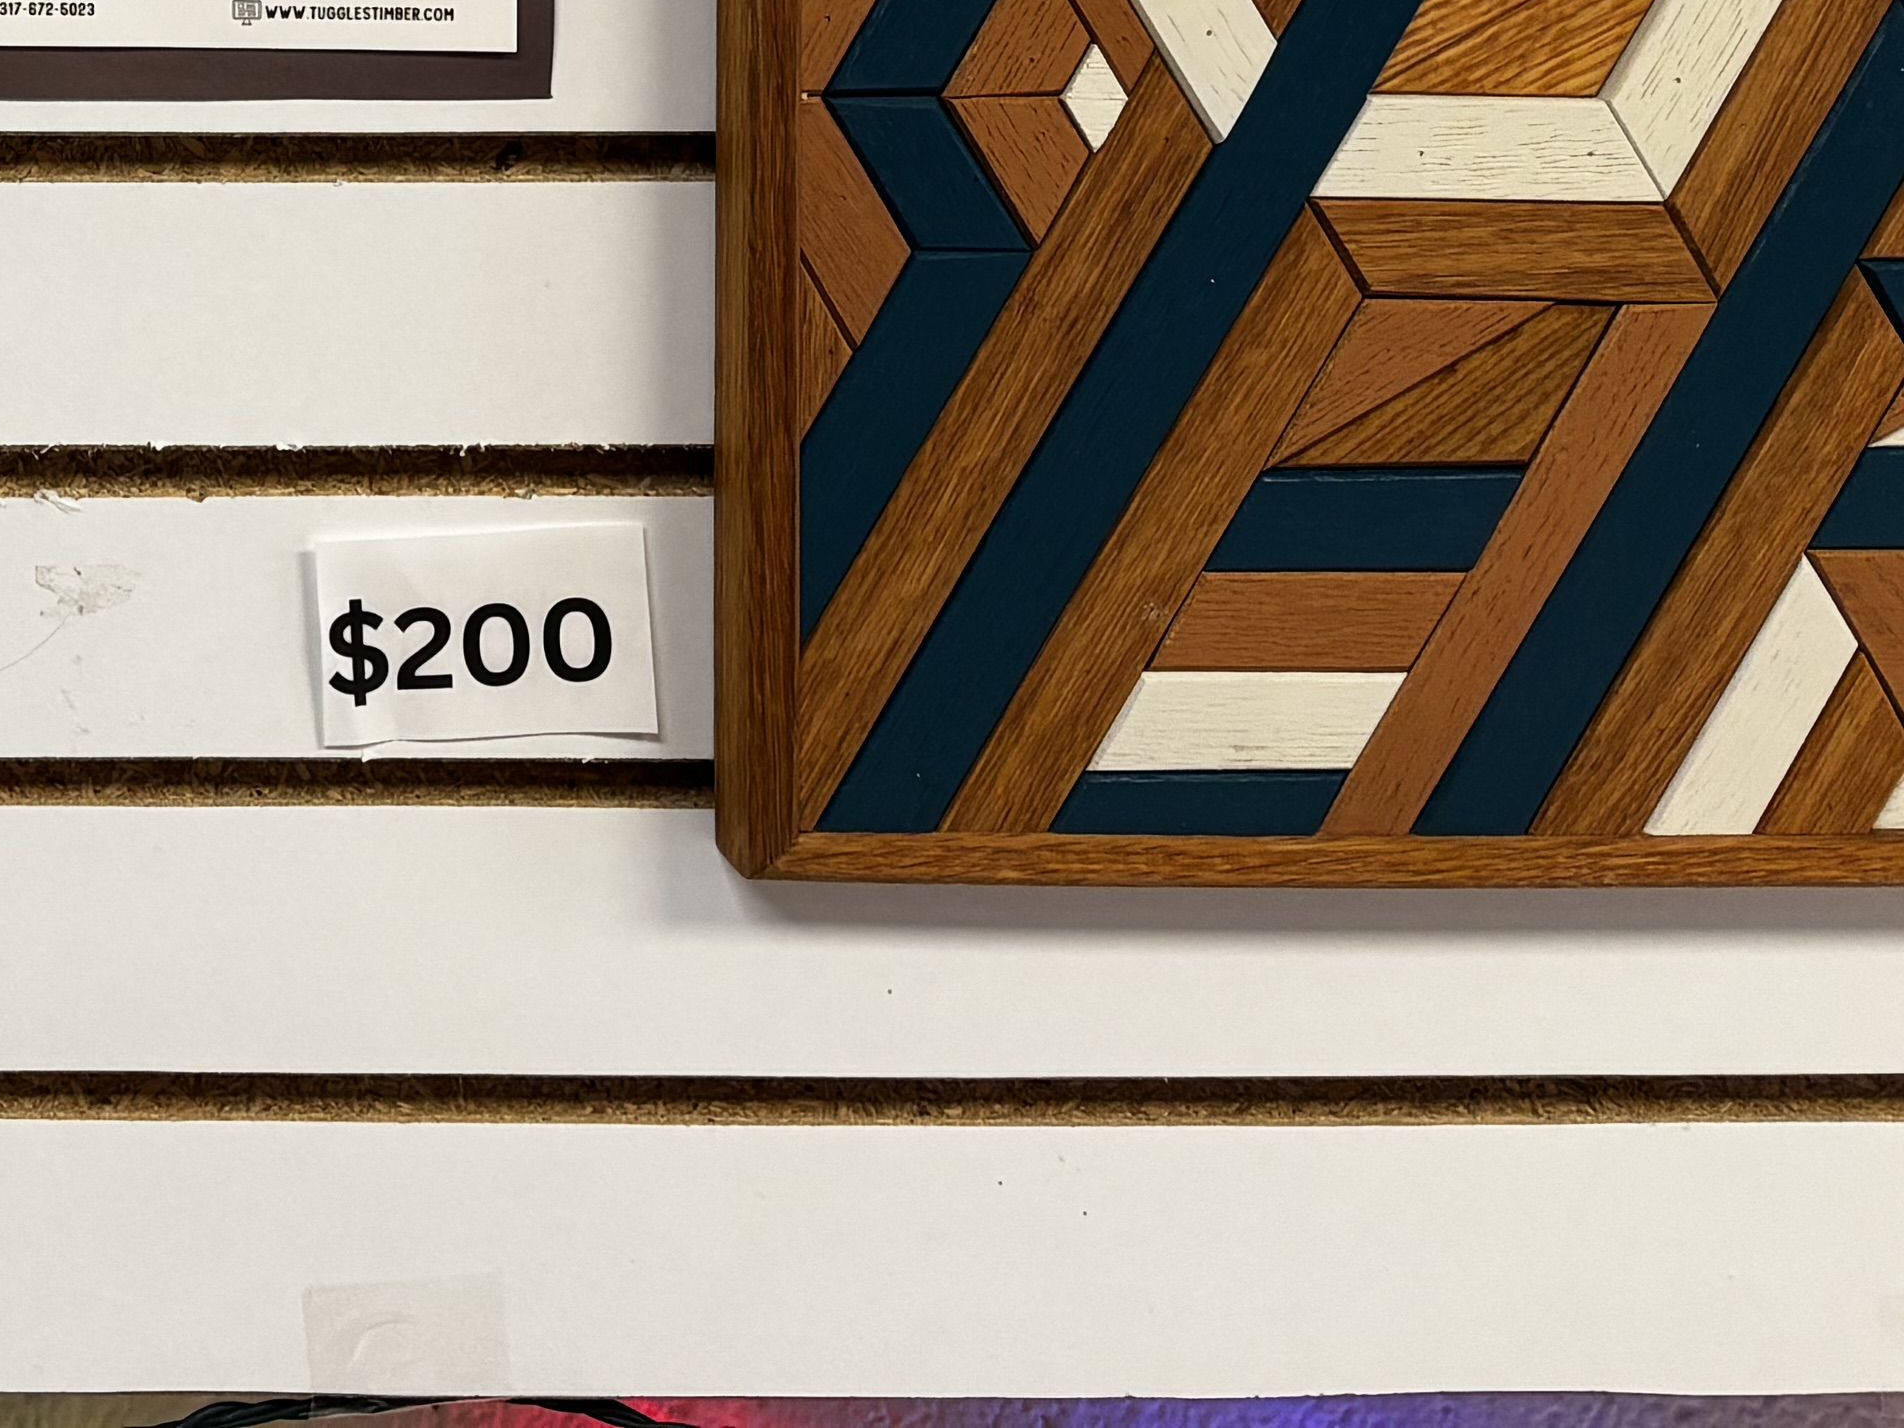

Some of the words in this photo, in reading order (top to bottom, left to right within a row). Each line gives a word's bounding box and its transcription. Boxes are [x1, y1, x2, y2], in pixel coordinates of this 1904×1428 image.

[0, 1, 94, 16] 317-672-5023
[265, 5, 454, 21] WWW.TUGGLESTIMBER.COM
[328, 597, 612, 707] $200
